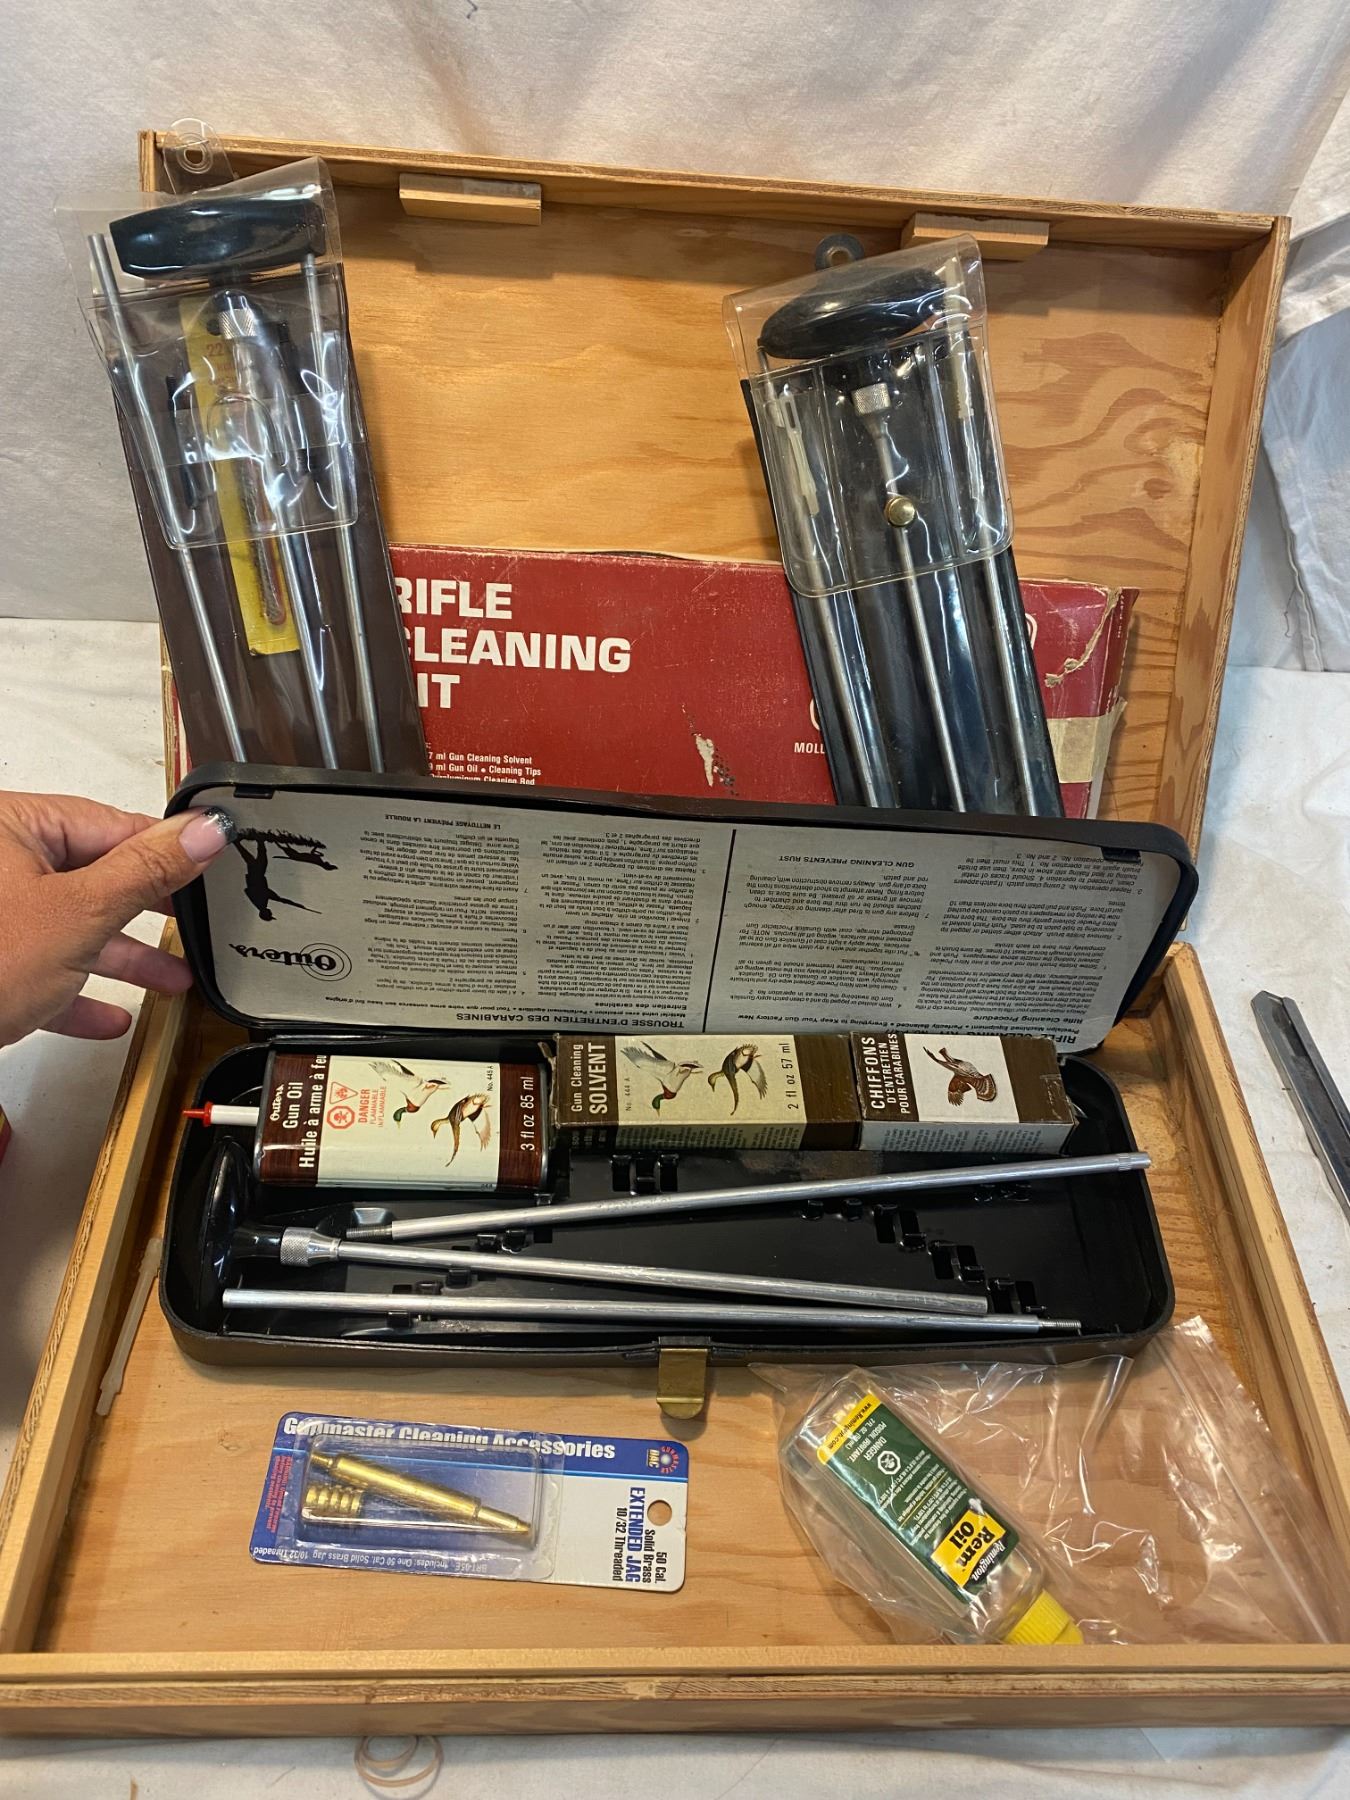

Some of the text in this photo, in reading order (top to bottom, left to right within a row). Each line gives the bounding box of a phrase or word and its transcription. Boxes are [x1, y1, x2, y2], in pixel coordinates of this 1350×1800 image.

[395, 577, 512, 619] RIFLE
[449, 752, 464, 760] Gun
[467, 753, 500, 764] Cleaning
[504, 755, 532, 764] Solvent
[436, 763, 445, 771] ml
[449, 763, 464, 772] Gun
[467, 764, 477, 772] Oil
[489, 766, 522, 776] Cleaning
[525, 767, 541, 777] Tips
[456, 1013, 523, 1021] CARABINES
[554, 1016, 628, 1026] D'ENTRETIEN
[632, 1020, 684, 1028] TROUSSE
[850, 1019, 888, 1027] Everything
[779, 1043, 790, 1053] ml
[781, 1059, 793, 1069] 57
[570, 1044, 584, 1112] Gun Cleaning
[588, 1042, 608, 1114] SOLVENT
[786, 1075, 795, 1084] oz
[861, 1037, 885, 1109] CHIFFONS
[878, 1042, 897, 1103] D'ENTRETIEN
[888, 1034, 911, 1114] POUR CARABINES
[520, 1076, 534, 1090] ml
[282, 1082, 303, 1129] Gun Oil
[358, 1089, 370, 1123] DANGER
[520, 1095, 534, 1109] 85
[299, 1131, 317, 1168] Huile
[309, 1084, 323, 1114] arme
[523, 1115, 534, 1127] oz
[520, 1143, 535, 1151] 3
[399, 1425, 489, 1450] Cleaning
[493, 1434, 616, 1459] Accessories
[862, 1435, 887, 1462] DANGER
[625, 1487, 645, 1582] EXTENDED JAG
[947, 1518, 977, 1550] Oil
[612, 1507, 627, 1580] 10/32 Threaded
[955, 1524, 996, 1572] Rem
[253, 1547, 288, 1557] Threaded
[313, 1550, 326, 1559] Jag
[328, 1552, 349, 1561] Brass
[350, 1554, 369, 1564] Solid
[642, 1529, 655, 1583] Solid Brass
[387, 1557, 396, 1565] 50
[398, 1558, 412, 1567] One
[655, 1552, 667, 1583] 50 Cal.
[968, 1538, 1007, 1583] Remington
